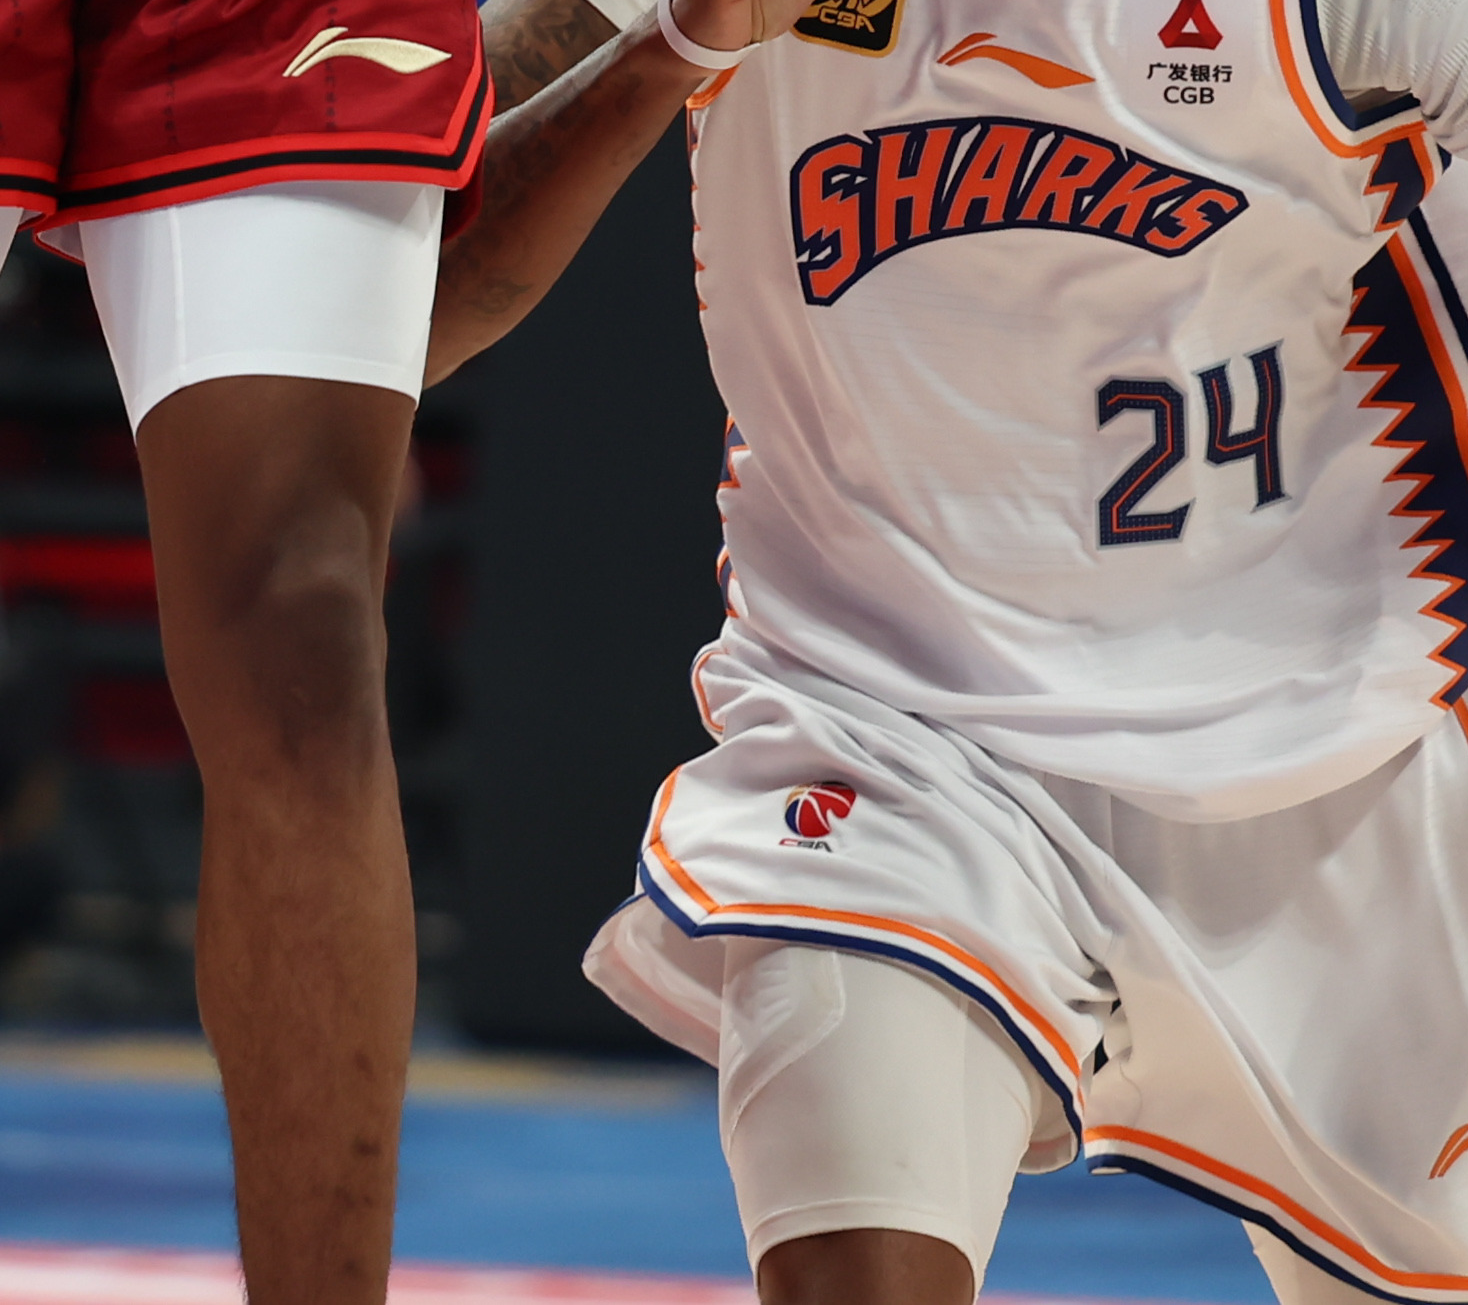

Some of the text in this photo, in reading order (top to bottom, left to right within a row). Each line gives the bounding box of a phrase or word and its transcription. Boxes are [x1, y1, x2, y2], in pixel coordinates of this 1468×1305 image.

[819, 6, 875, 33] CBA
[1147, 62, 1233, 83] 广发银行
[1163, 86, 1215, 104] CGB
[789, 115, 1250, 307] SHARKS
[1094, 338, 1291, 551] 24
